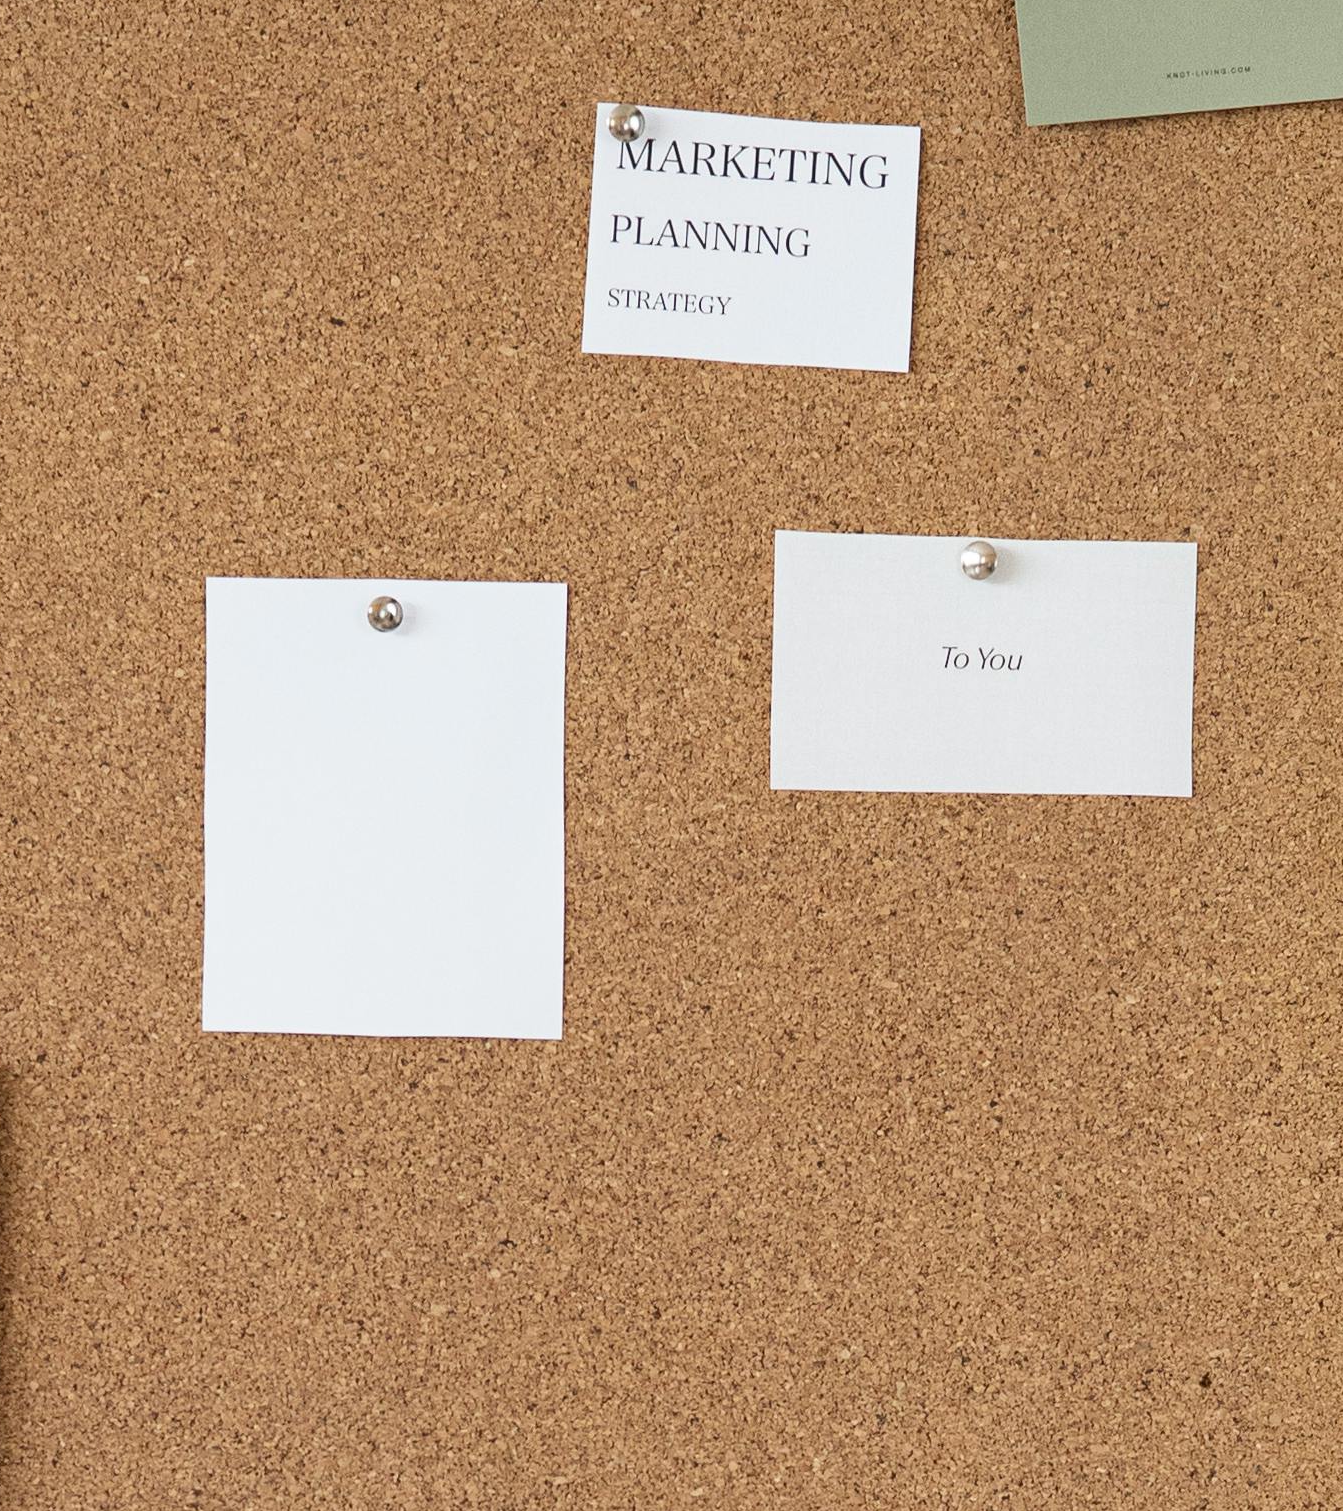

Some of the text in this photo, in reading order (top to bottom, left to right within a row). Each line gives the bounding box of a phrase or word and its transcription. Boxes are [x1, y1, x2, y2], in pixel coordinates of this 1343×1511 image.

[617, 138, 889, 190] MARKETING
[610, 214, 811, 258] PLANNING
[607, 287, 732, 316] STRATEGY
[941, 645, 1023, 672] To You
